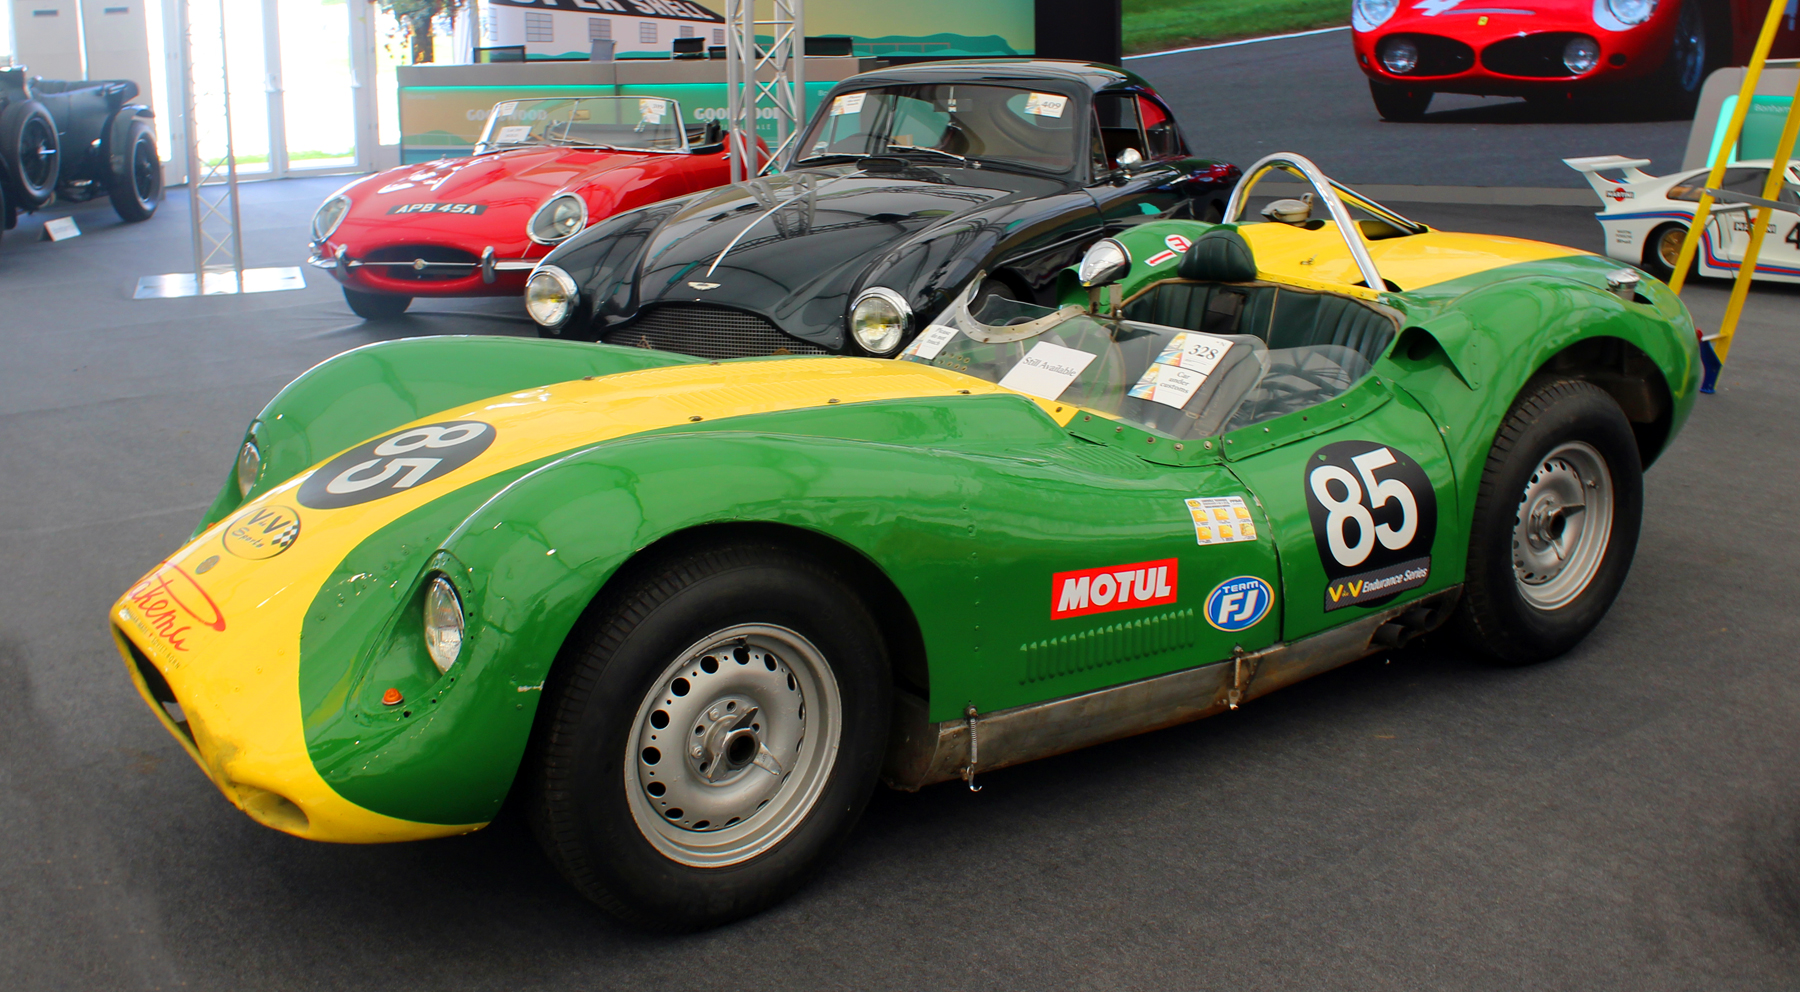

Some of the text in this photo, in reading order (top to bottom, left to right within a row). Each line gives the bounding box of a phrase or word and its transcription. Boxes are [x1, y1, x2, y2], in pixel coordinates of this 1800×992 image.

[1041, 101, 1062, 110] 409
[1754, 103, 1792, 113] Bonham
[395, 203, 477, 215] APB 45A
[1188, 344, 1219, 360] 328
[1022, 356, 1078, 378] Still Available
[1168, 377, 1190, 387] under
[1176, 371, 1191, 380] Car
[1159, 382, 1189, 394] customs
[327, 422, 488, 494] 85
[1309, 447, 1418, 567] 85
[231, 526, 264, 549] Sports
[1222, 580, 1259, 594] TEAM
[1361, 573, 1404, 593] Endurance
[1403, 567, 1428, 582] Series
[1057, 566, 1171, 612] MOTUL
[1218, 589, 1259, 624] FJ
